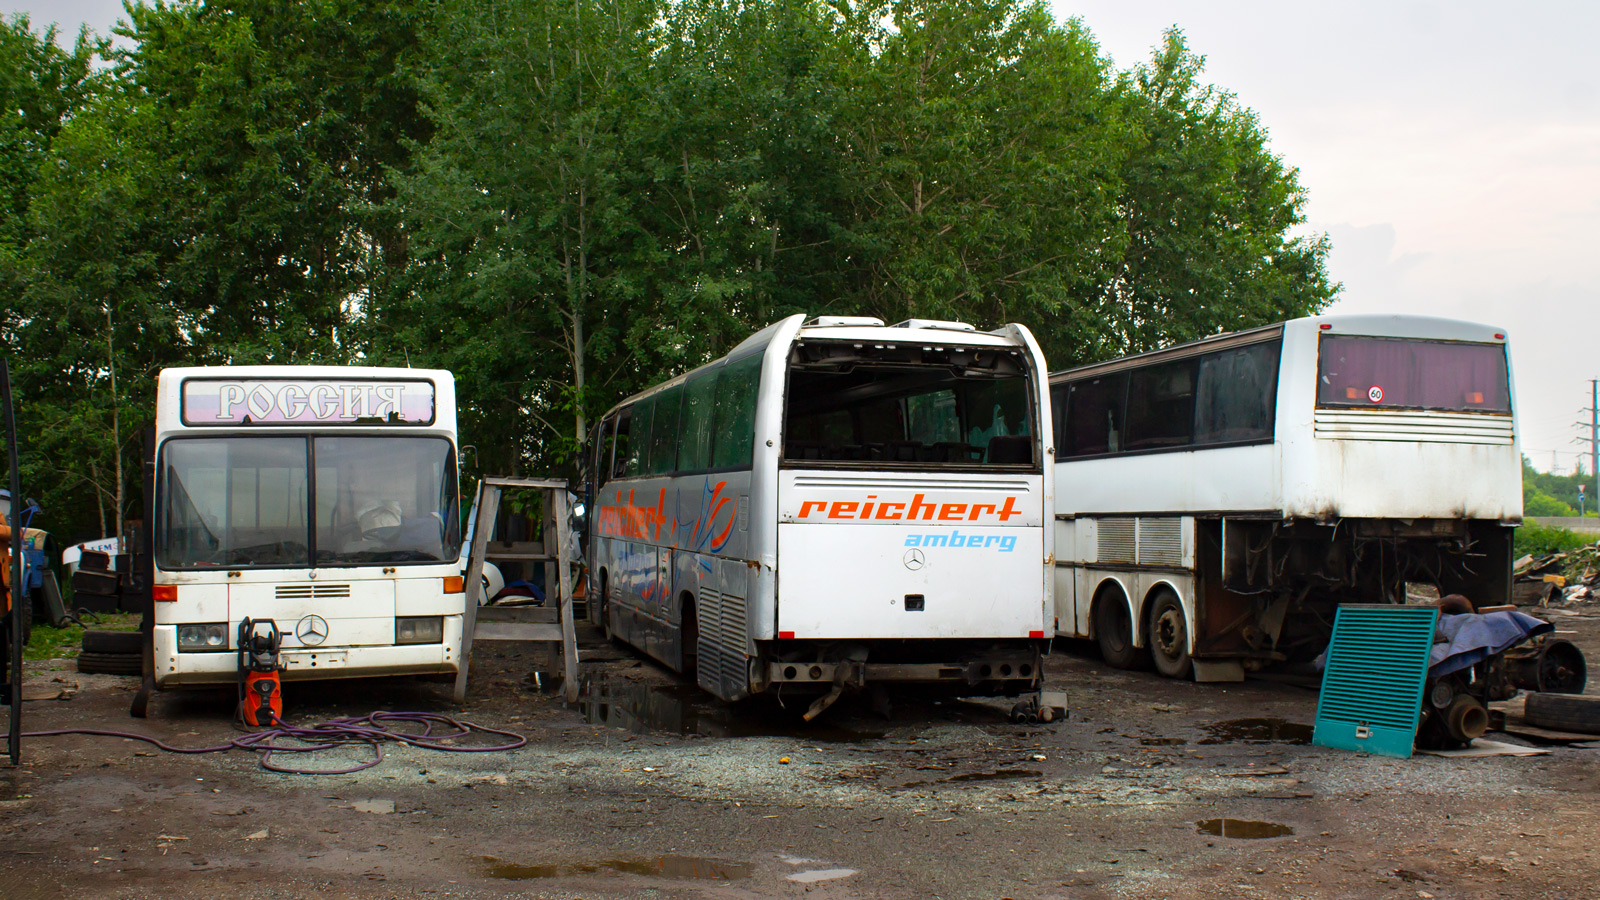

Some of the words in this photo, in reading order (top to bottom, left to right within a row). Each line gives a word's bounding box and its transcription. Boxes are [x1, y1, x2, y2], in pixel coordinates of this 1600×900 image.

[216, 384, 406, 419] РОССИЯ
[1371, 389, 1382, 399] 60
[598, 487, 667, 541] reichert
[797, 493, 1023, 522] reichert
[904, 530, 1018, 553] amberg
